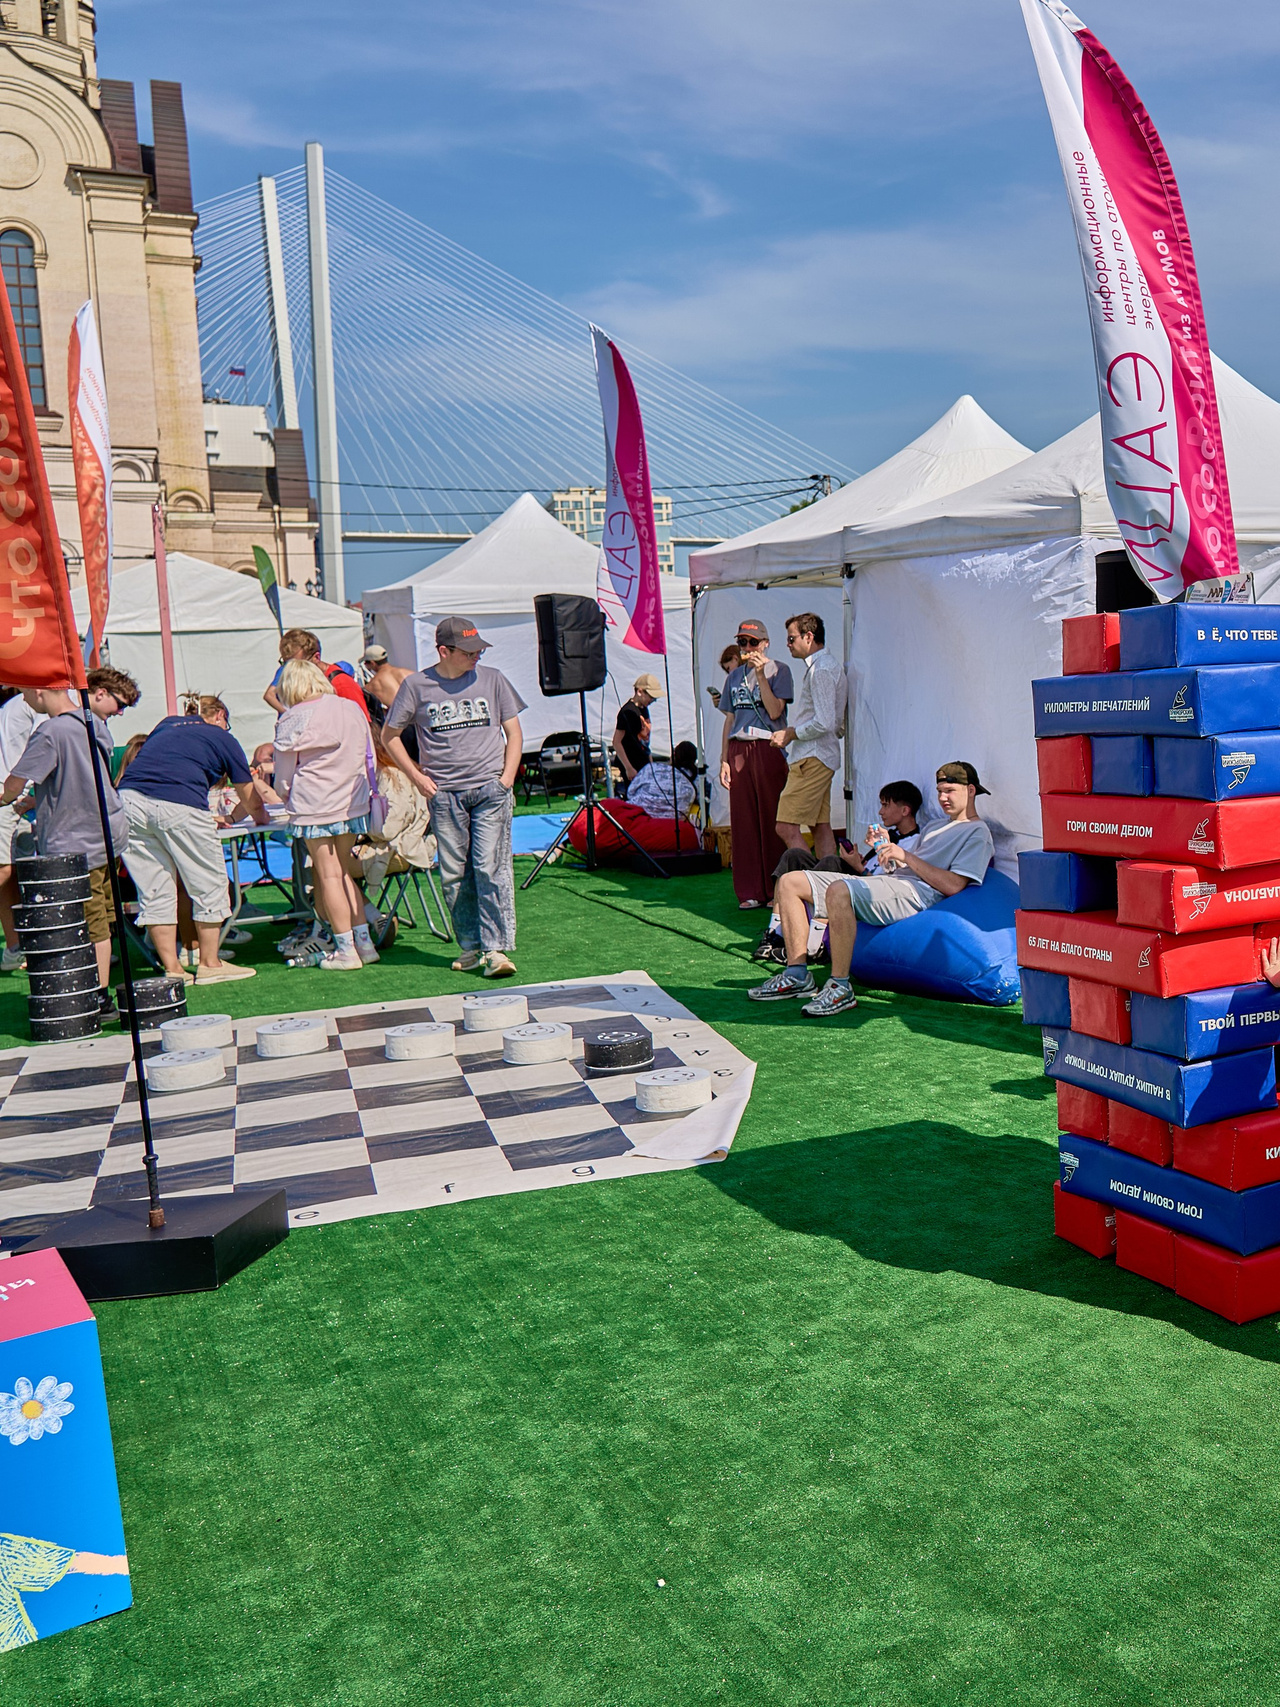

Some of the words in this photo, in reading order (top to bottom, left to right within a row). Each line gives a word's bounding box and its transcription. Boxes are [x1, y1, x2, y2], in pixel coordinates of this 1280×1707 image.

[1071, 150, 1116, 323] информационные
[1111, 229, 1126, 253] по
[1152, 229, 1189, 309] АТОМОВ
[1116, 257, 1137, 326] центры
[1179, 313, 1193, 340] ИЗ
[1106, 351, 1181, 583] ИЦАЭ
[7, 537, 46, 637] ЧТО
[1225, 629, 1249, 641] ЧТО
[1250, 629, 1278, 641] ТЕБЕ
[1044, 701, 1090, 714] КИЛОМЕТРЫ
[1091, 696, 1150, 712] ВПЕЧАТЛЕНИЙ
[1066, 820, 1088, 833] ГОРИ
[1088, 821, 1119, 836] СВОИМ
[1120, 823, 1153, 838] ДЕЛОМ
[1028, 935, 1037, 947] 65
[1037, 937, 1050, 950] ЛЕТ
[1050, 940, 1060, 953] НА
[1060, 942, 1083, 957] БЛАГО
[1083, 946, 1113, 962] СТРАНЫ
[1199, 1013, 1235, 1032] ТВОЙ
[1064, 1053, 1086, 1071] ПОЖАР
[1087, 1063, 1108, 1078] ГОРИТ
[1109, 1069, 1135, 1088] ДУШАХ
[1136, 1081, 1164, 1099] НАШИХ
[1165, 1089, 1171, 1100] В
[1109, 1178, 1142, 1199] ДЕЛОМ
[1143, 1190, 1175, 1210] СВОИМ
[1176, 1201, 1203, 1219] ГОРИ
